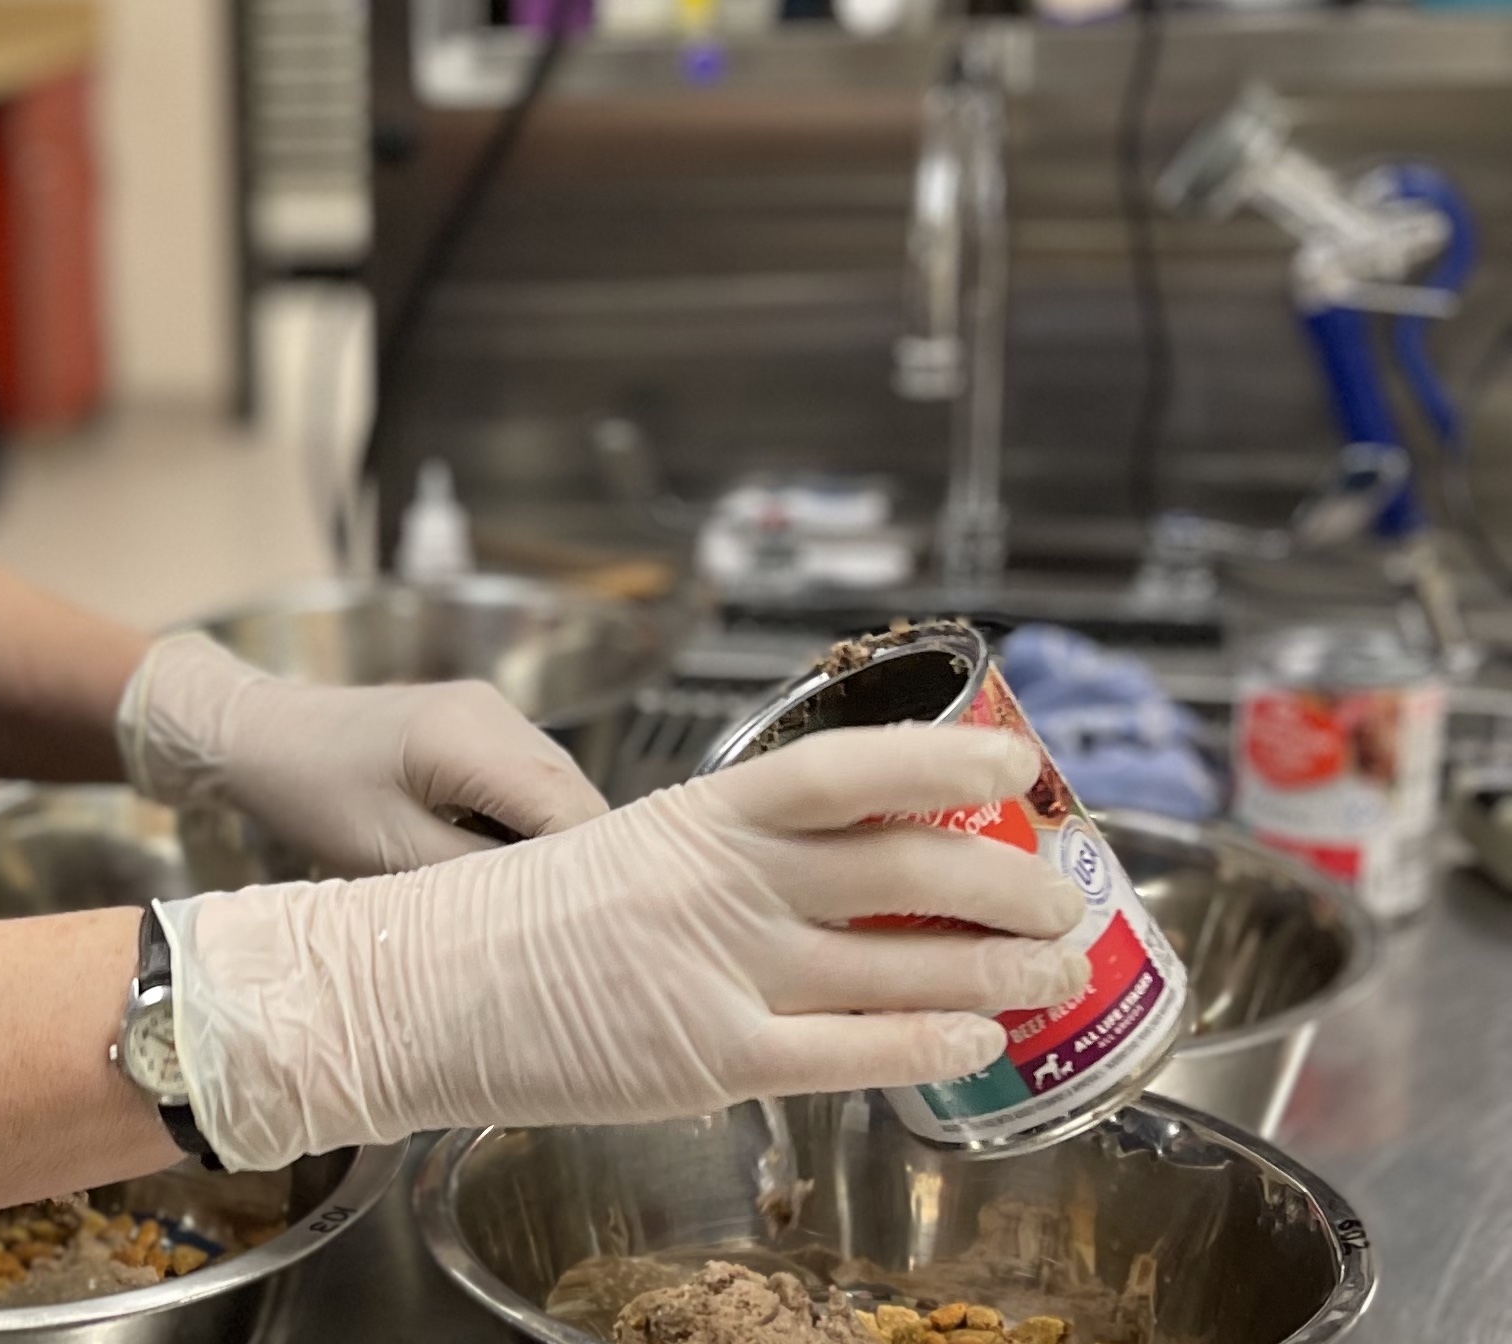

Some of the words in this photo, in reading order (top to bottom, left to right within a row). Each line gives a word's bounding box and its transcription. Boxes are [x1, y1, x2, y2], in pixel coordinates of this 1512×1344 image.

[1073, 841, 1100, 887] USA
[1007, 1013, 1048, 1044] BEEF
[1073, 1030, 1100, 1054] ALL
[1095, 1009, 1122, 1035] LIFE
[1118, 971, 1154, 1018] STAGES
[309, 1206, 357, 1234] 103
